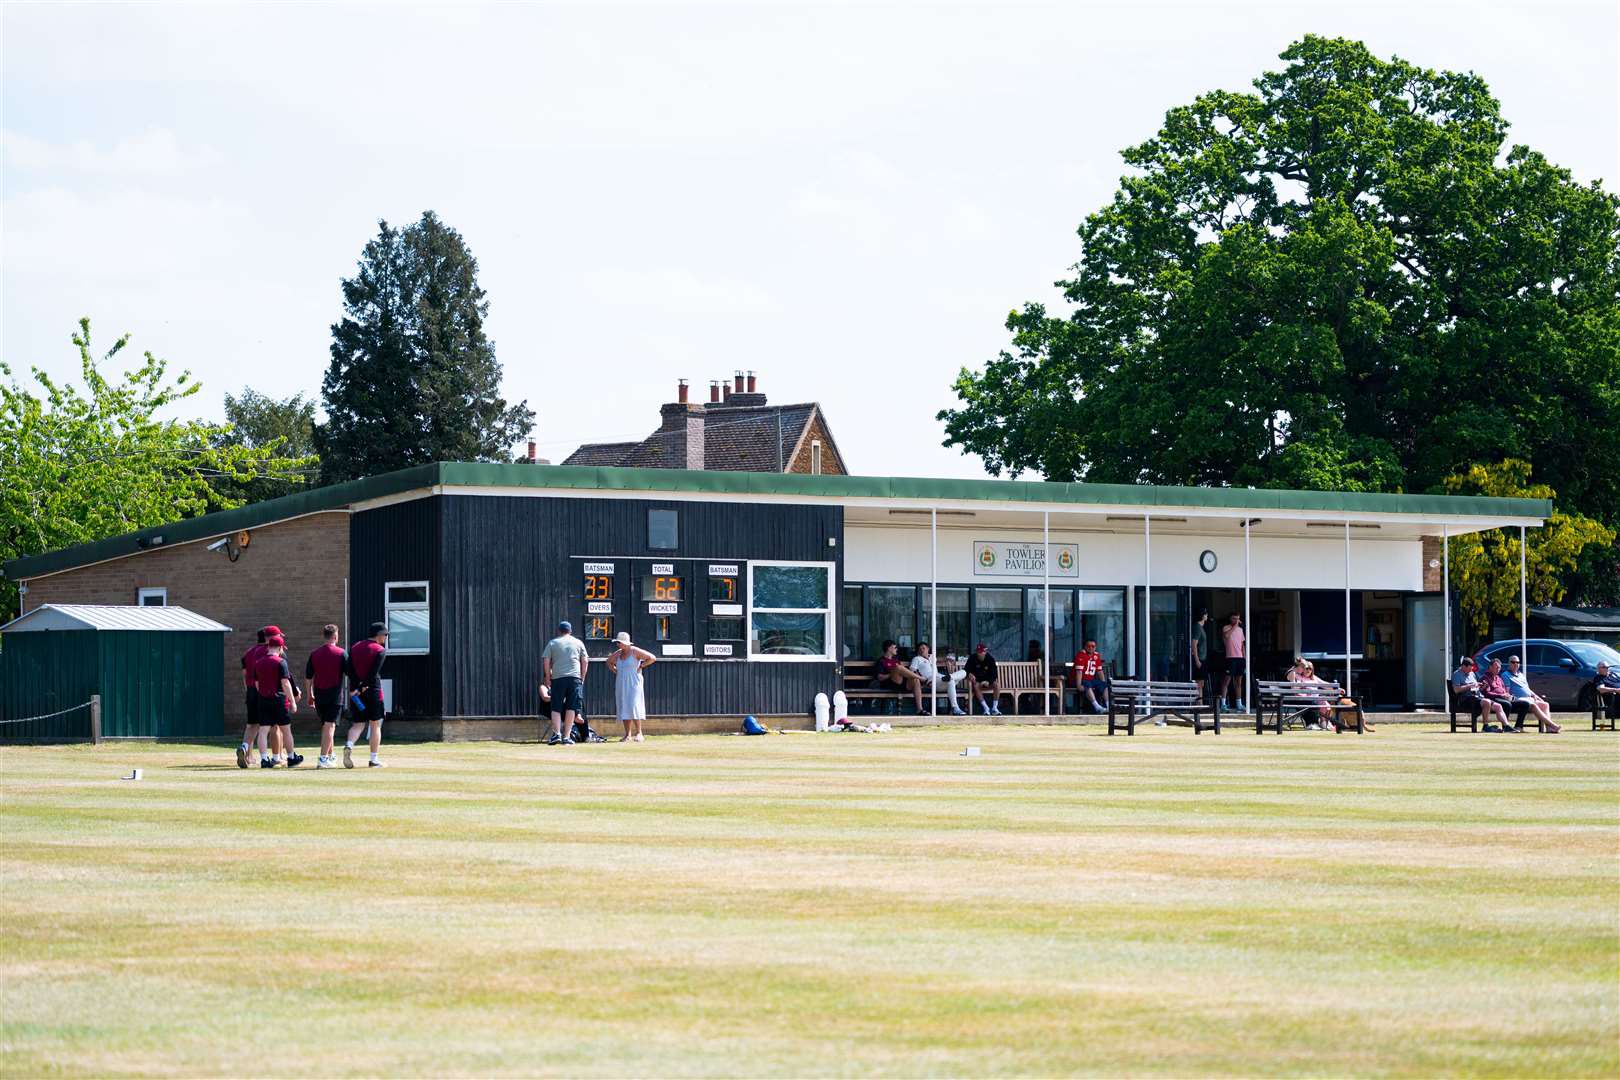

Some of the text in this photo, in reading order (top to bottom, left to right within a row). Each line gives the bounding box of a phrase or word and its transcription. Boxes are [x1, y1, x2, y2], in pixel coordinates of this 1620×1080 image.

[1006, 549, 1046, 559] TOWLER
[585, 565, 614, 573] BATSMAN
[654, 565, 673, 573] TOTAL
[709, 566, 737, 574] BATSMAN
[584, 575, 609, 599] 33
[655, 577, 680, 600] 62
[723, 578, 733, 600] 7
[589, 603, 611, 611] OVERS
[650, 604, 677, 612] WICKETS
[592, 618, 609, 638] 14
[706, 646, 731, 654] VISITORS
[1084, 660, 1096, 675] 15
